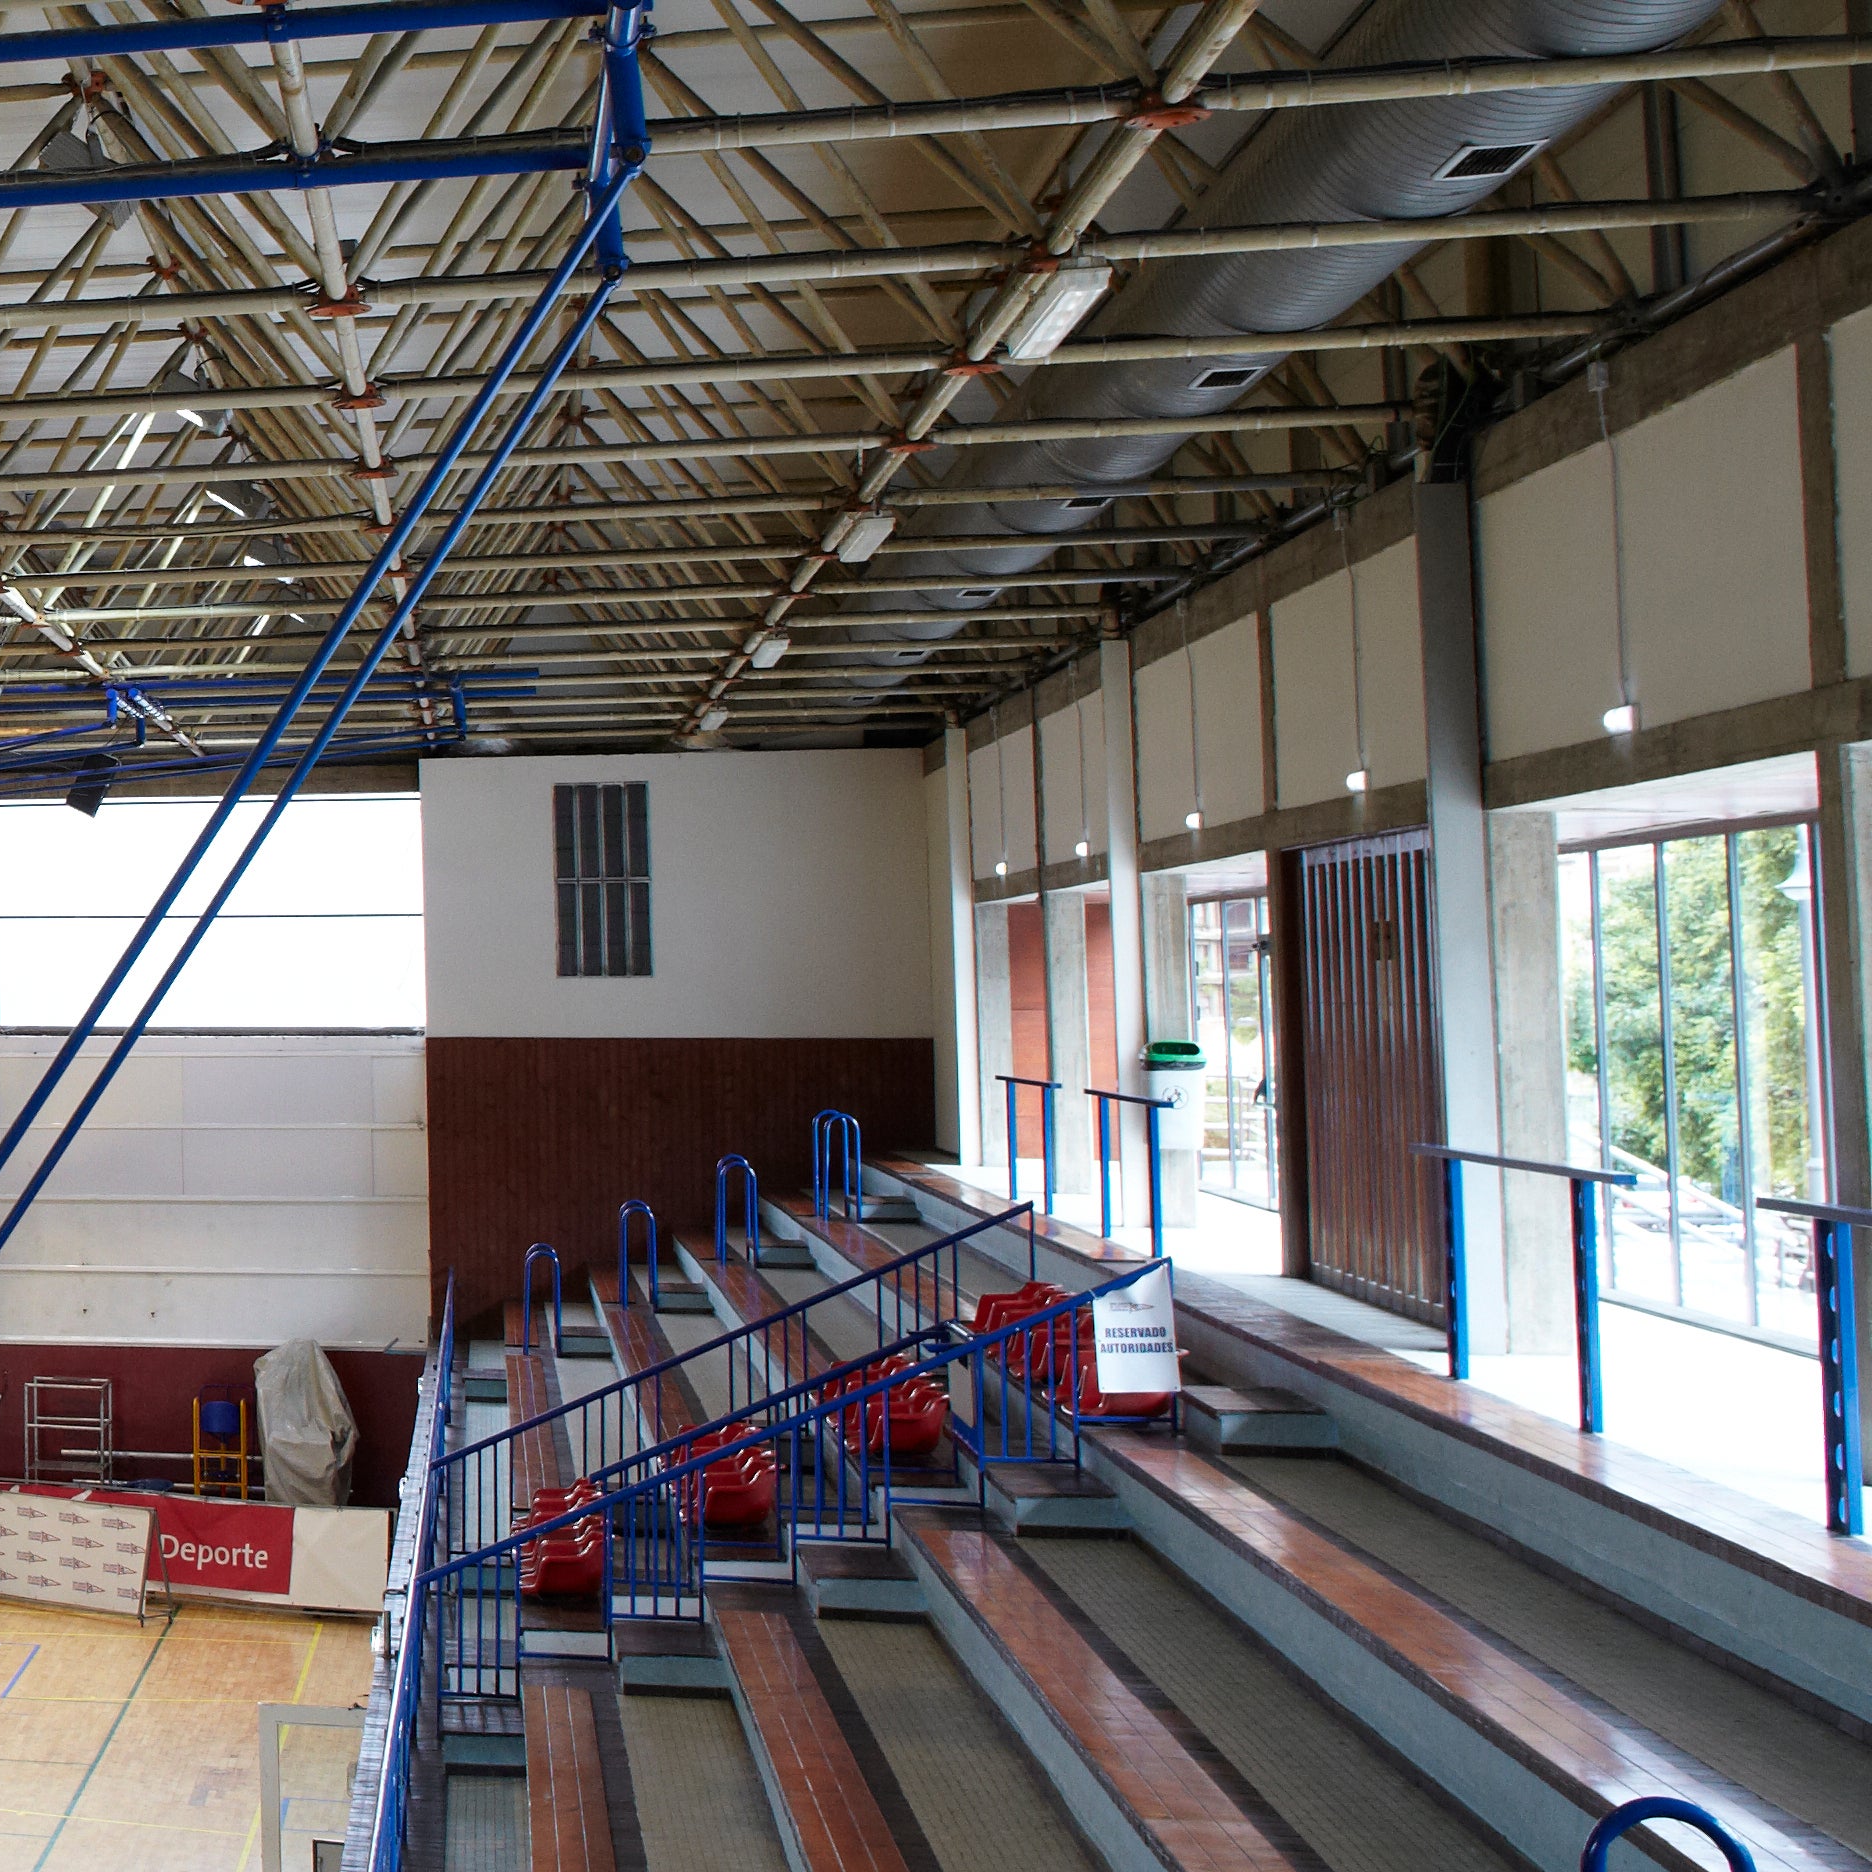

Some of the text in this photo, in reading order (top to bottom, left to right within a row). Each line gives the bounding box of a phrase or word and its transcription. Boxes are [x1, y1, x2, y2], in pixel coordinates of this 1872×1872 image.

[1105, 1326, 1167, 1338] RESERVADO
[1100, 1342, 1174, 1353] AUTORIDADES
[159, 1533, 269, 1571] Deporte
